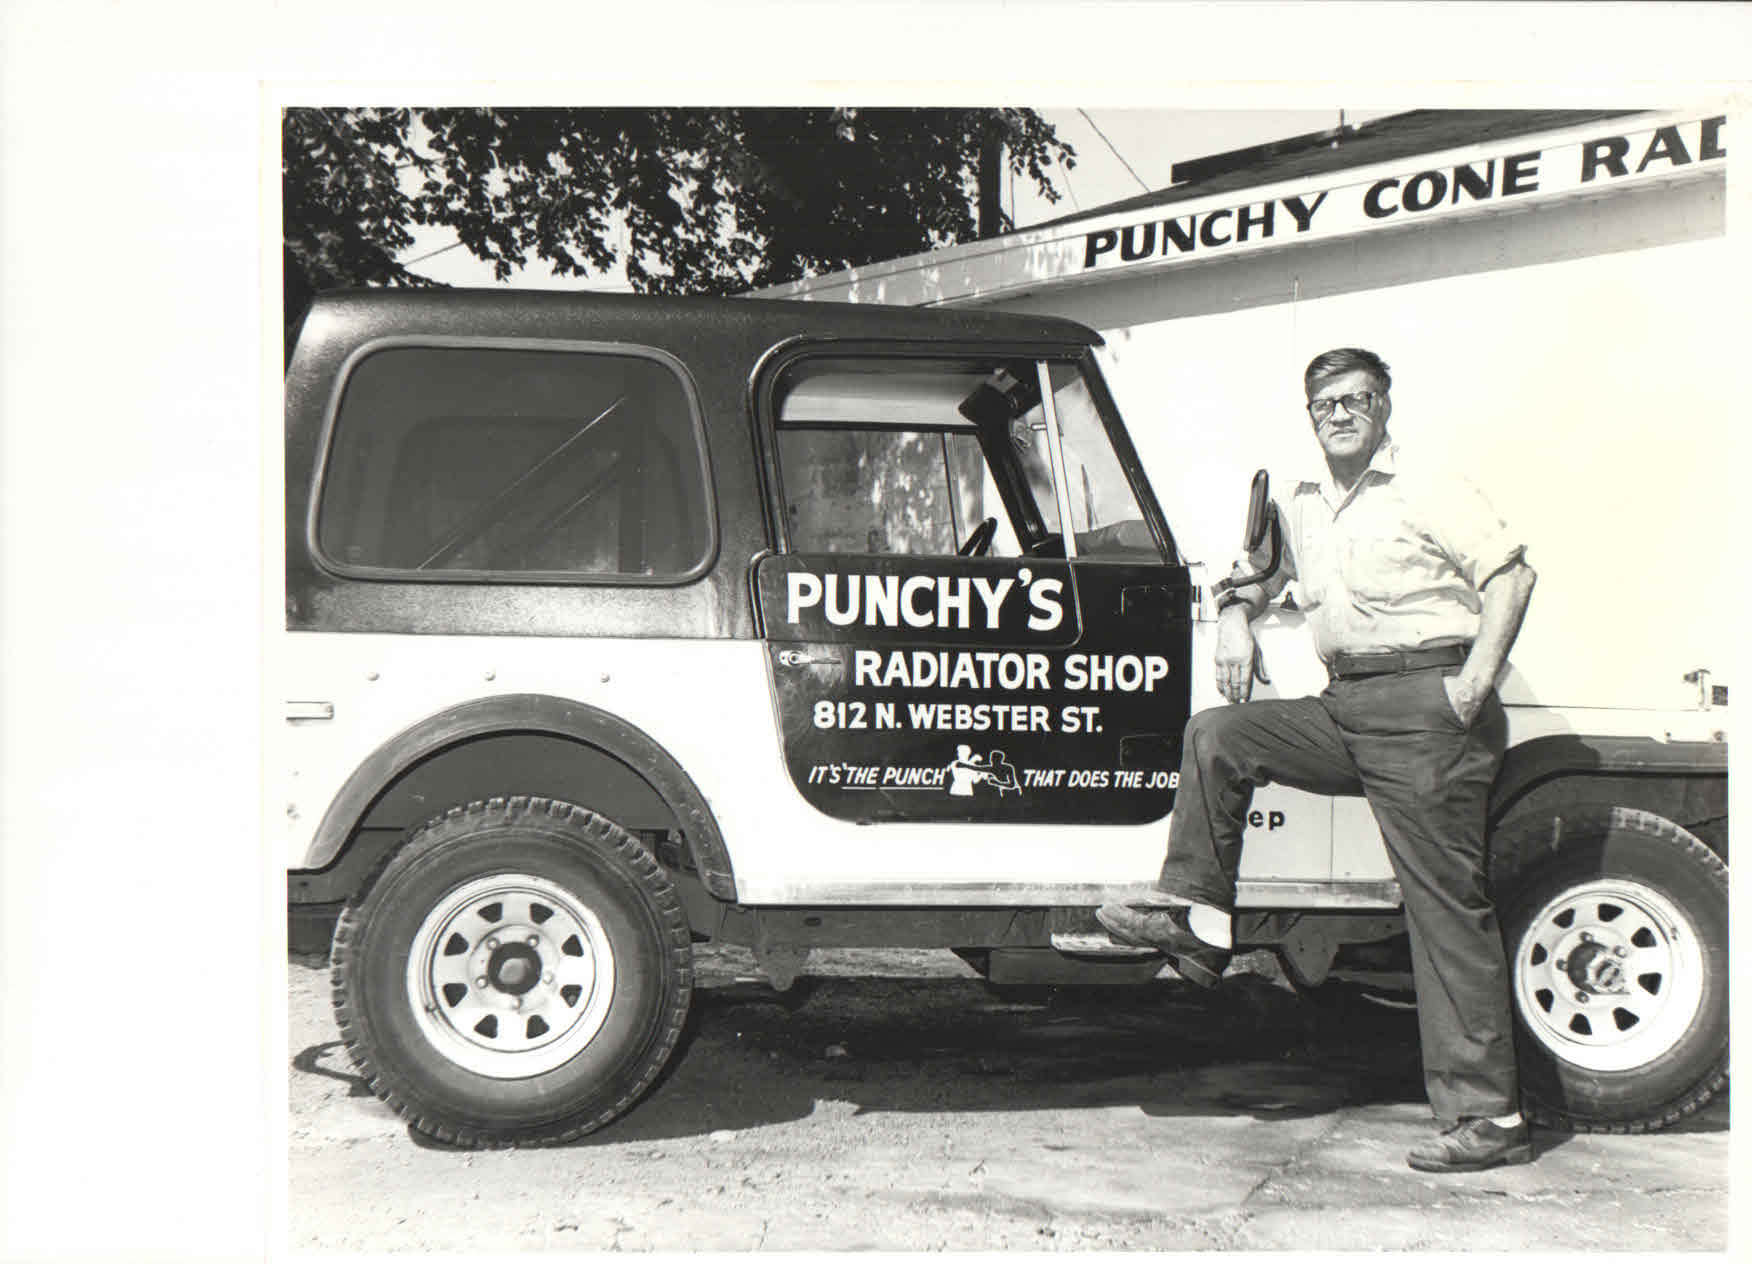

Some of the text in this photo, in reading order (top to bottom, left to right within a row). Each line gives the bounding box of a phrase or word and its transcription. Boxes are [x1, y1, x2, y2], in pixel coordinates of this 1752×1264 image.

[1084, 191, 1328, 268] PUNCHY
[1363, 151, 1540, 220] CONE
[787, 568, 1064, 631] PUNCHY'S
[855, 650, 1169, 692] RADIATOR SHOP
[813, 701, 1103, 733] 812 N. WEBSTER ST.
[808, 763, 842, 784] IT'S
[1023, 769, 1066, 788] THAT
[1067, 770, 1109, 789] DOES
[1114, 770, 1144, 789] THE
[1248, 810, 1285, 832] ep
